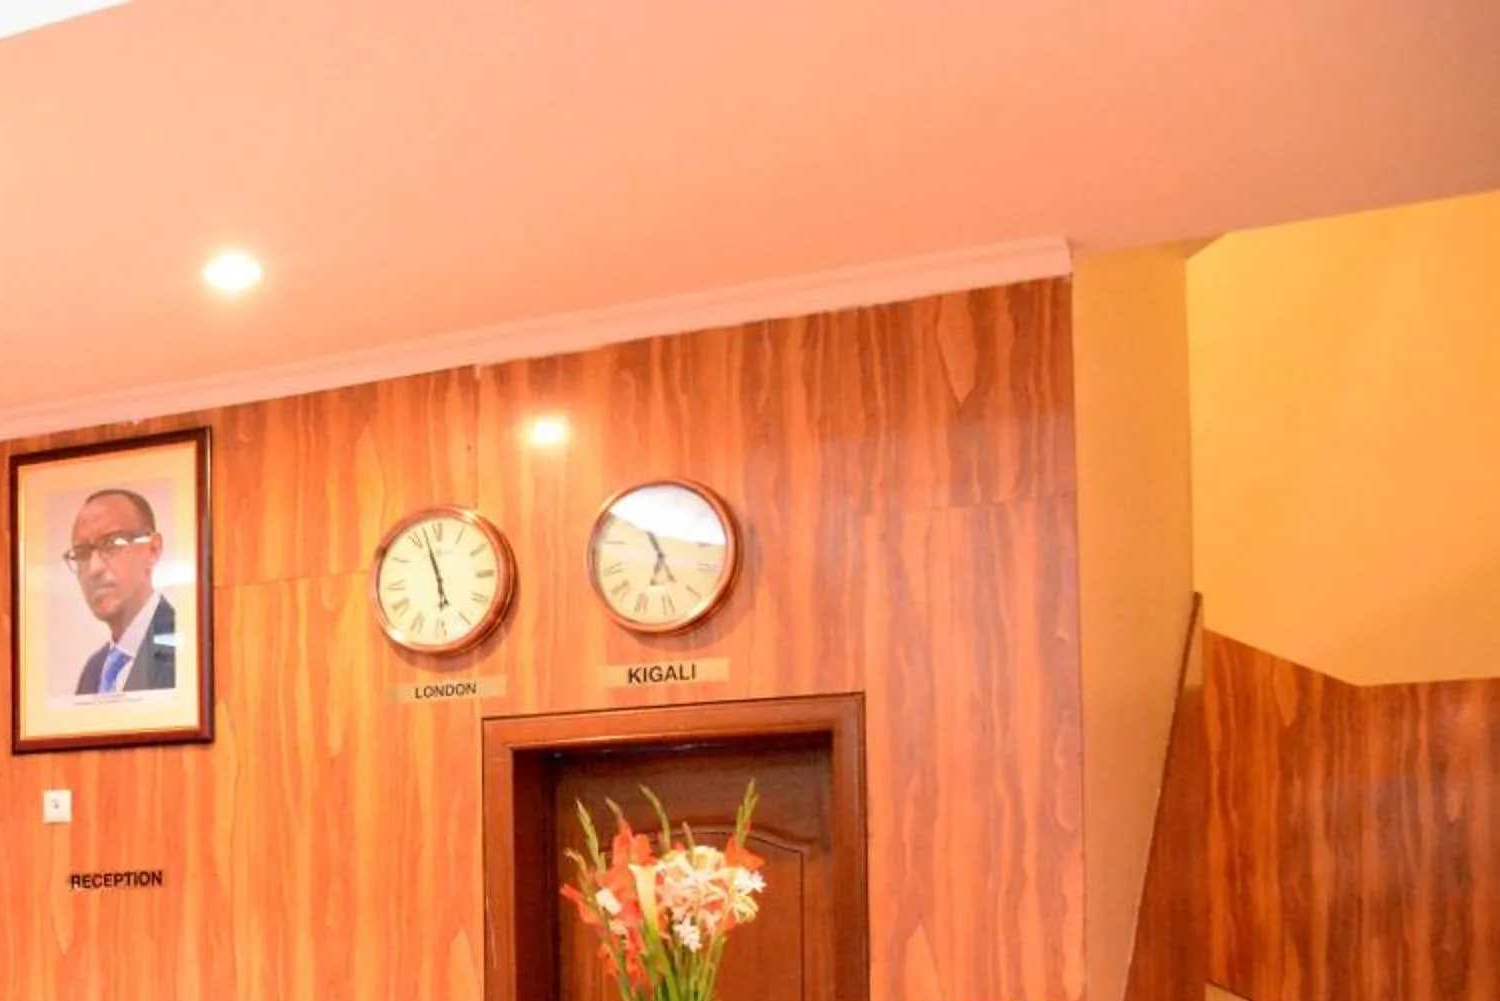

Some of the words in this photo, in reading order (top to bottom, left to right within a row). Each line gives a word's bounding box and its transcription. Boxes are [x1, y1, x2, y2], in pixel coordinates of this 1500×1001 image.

[627, 663, 696, 684] KIGALI
[414, 682, 477, 700] LONDON
[71, 870, 163, 889] RECEPTION
